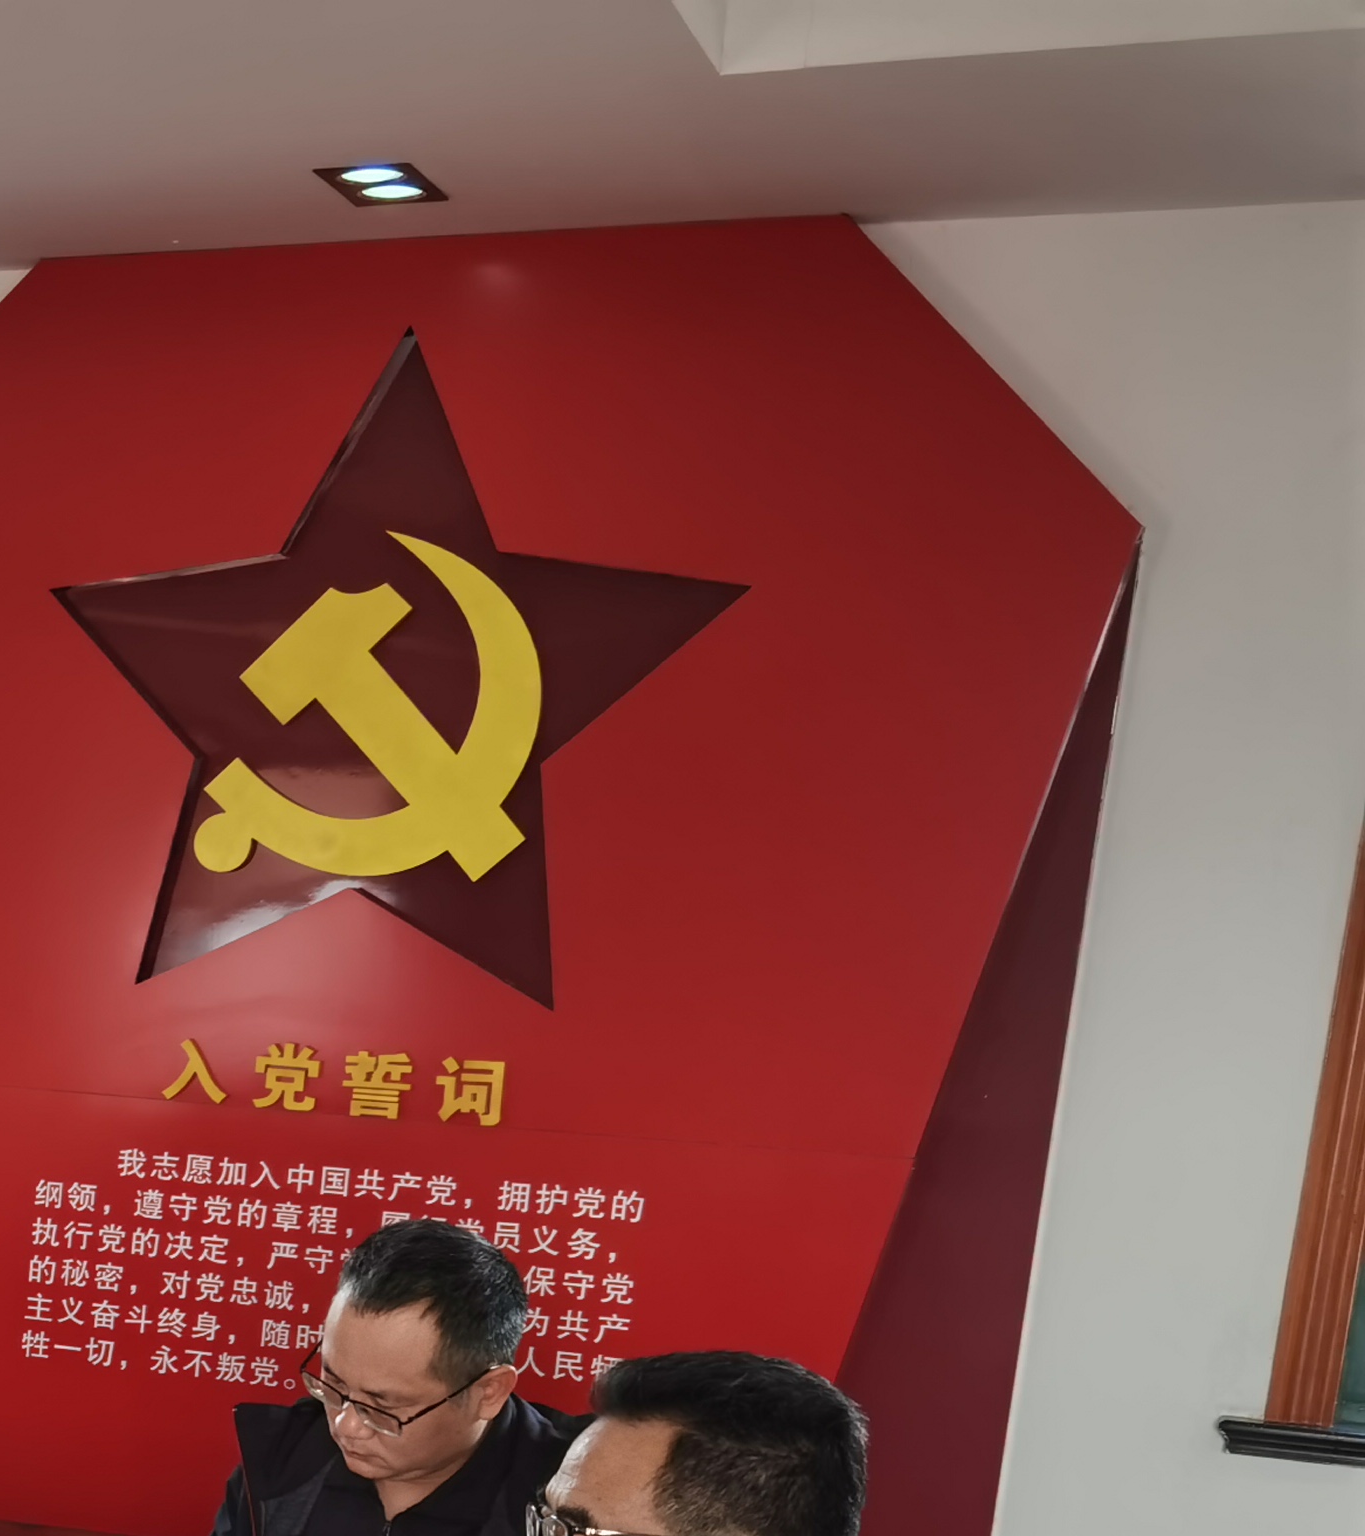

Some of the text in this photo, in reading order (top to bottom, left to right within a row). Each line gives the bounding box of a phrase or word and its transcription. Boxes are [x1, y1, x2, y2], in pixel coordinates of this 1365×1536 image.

[161, 1038, 507, 1127] 入党誓词
[34, 1179, 622, 1264] 纲领，遵守党的章程，员义务，
[117, 1147, 646, 1223] 我志愿加入中国共产党，拥护党的
[21, 1329, 298, 1391] 牲一切，永不叛党。
